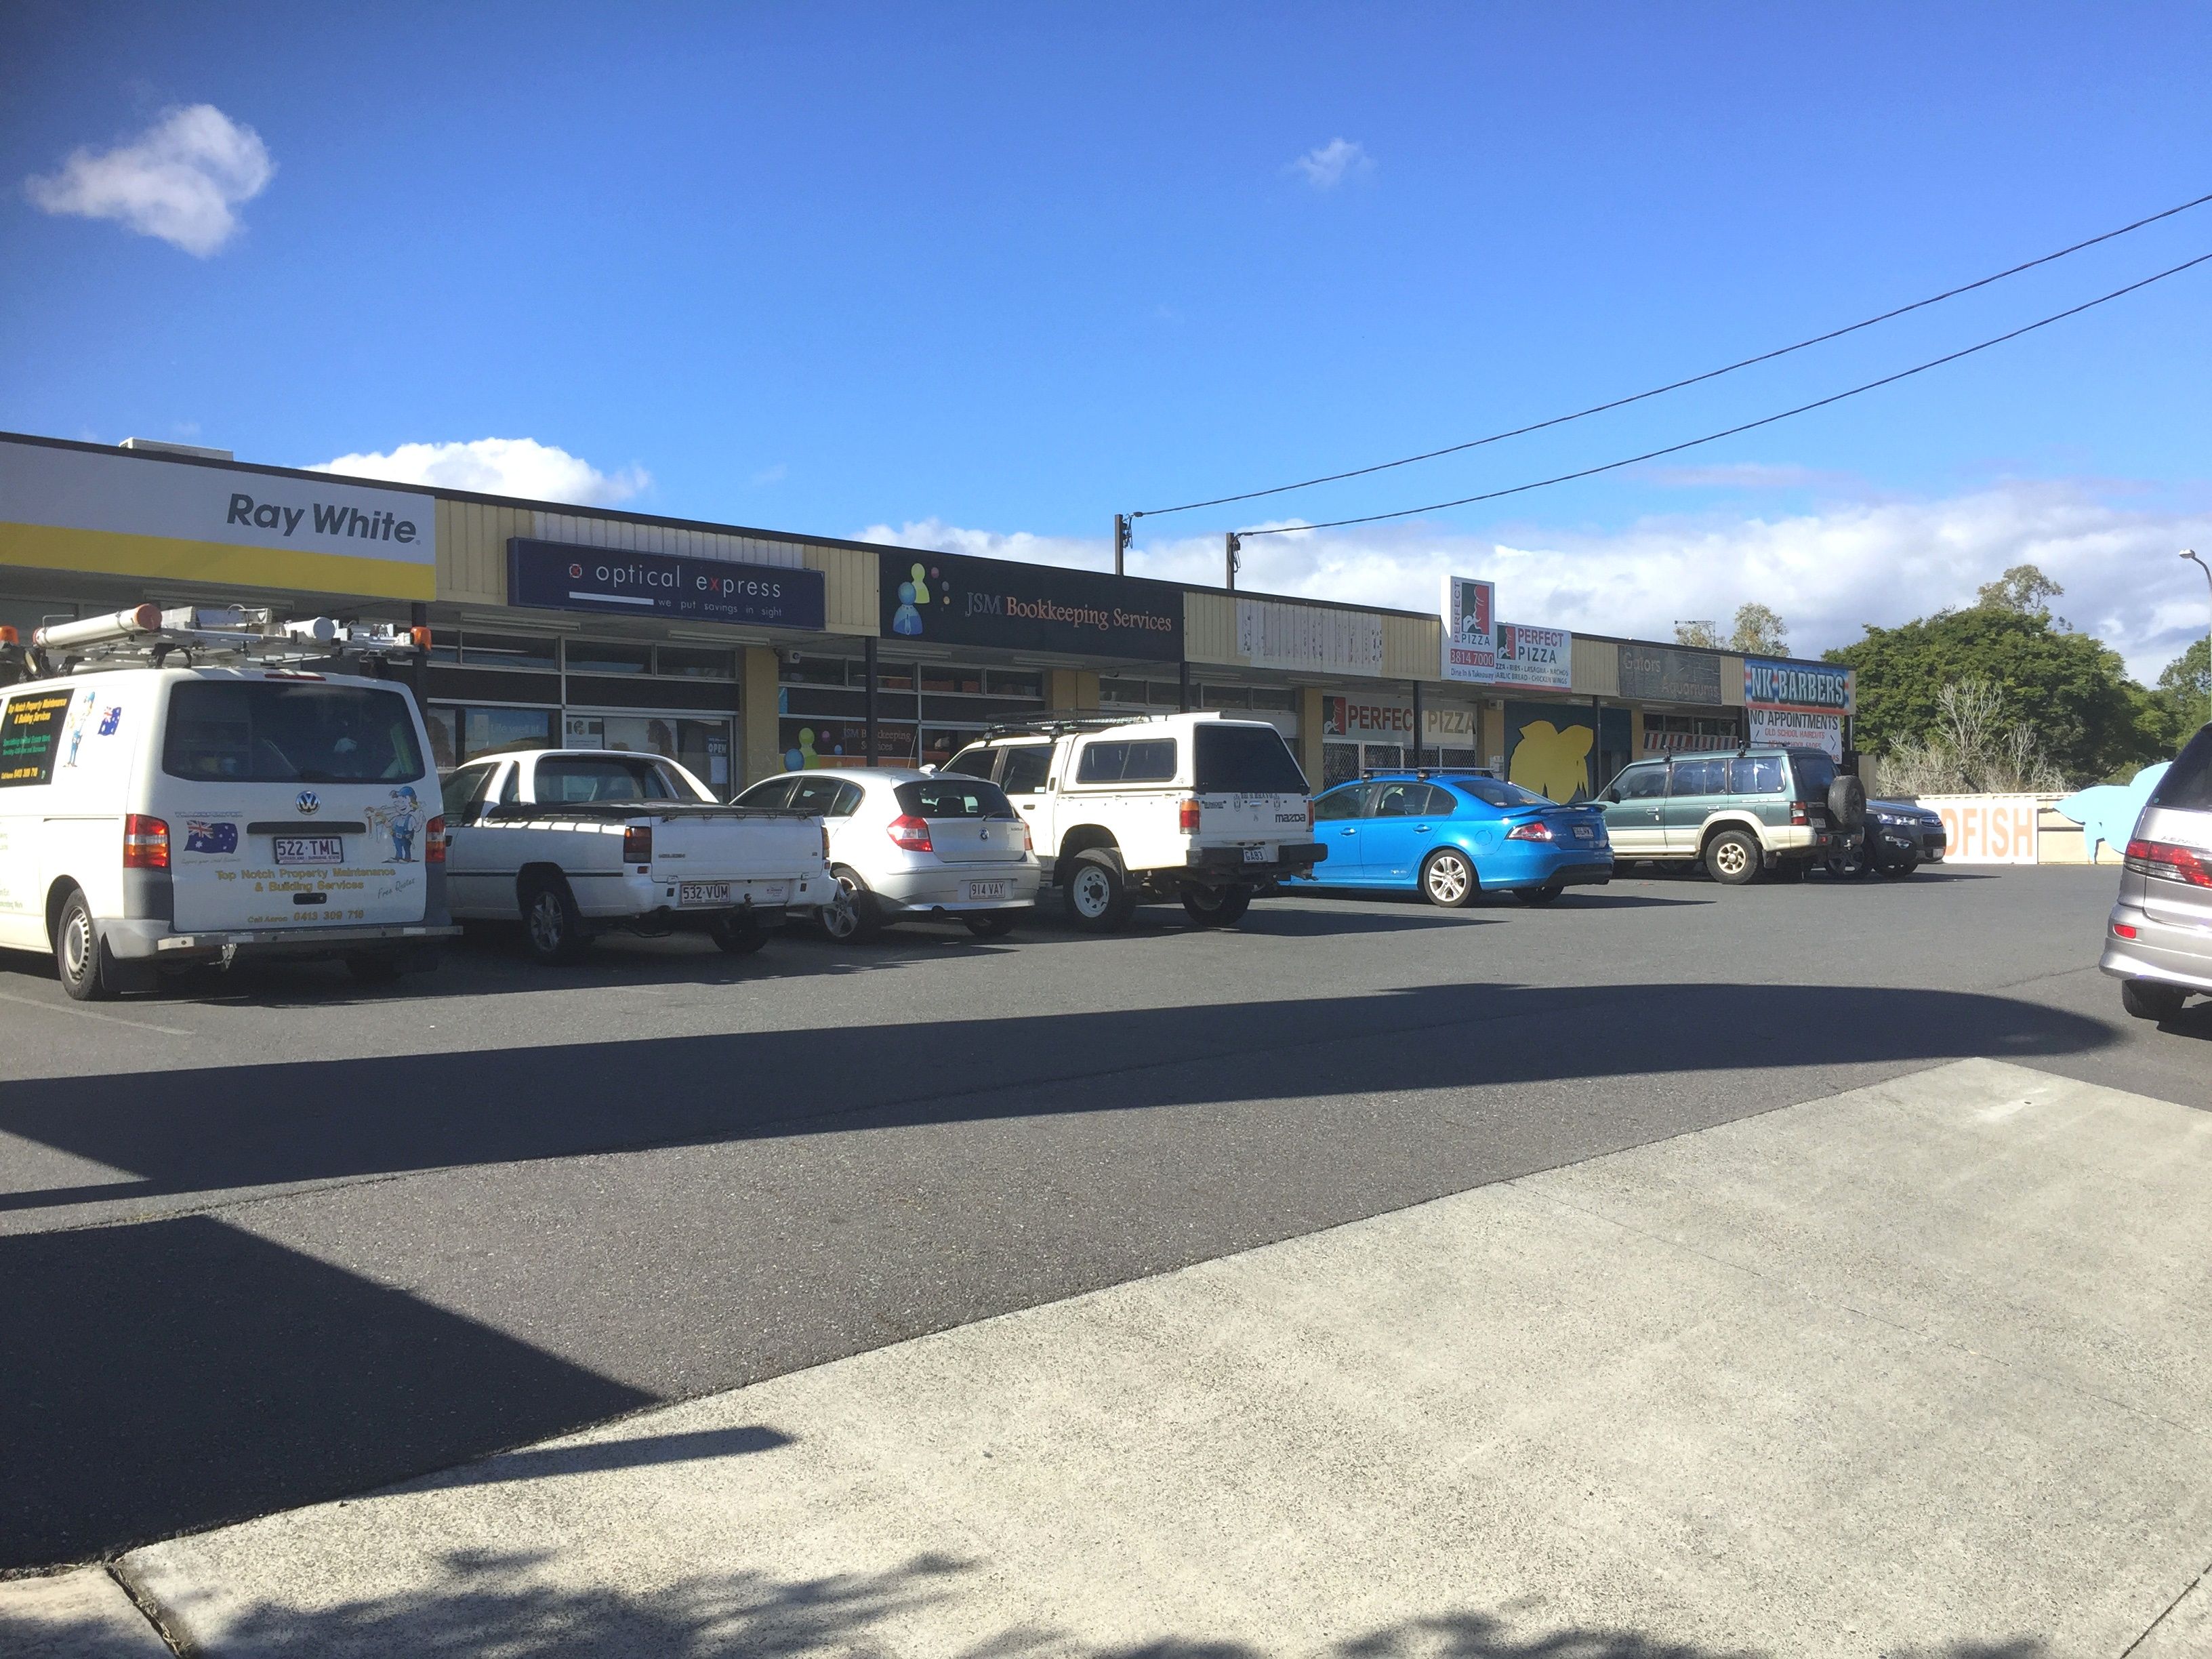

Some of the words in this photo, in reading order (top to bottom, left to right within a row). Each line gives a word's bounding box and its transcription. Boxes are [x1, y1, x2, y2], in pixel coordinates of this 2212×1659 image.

[226, 493, 305, 537] Ray
[312, 503, 417, 544] White
[596, 564, 680, 588] optical
[696, 576, 781, 598] express
[658, 599, 672, 607] we
[680, 600, 696, 610] put
[704, 602, 738, 615] savings
[745, 606, 754, 614] in
[761, 607, 782, 619] sight
[964, 591, 1002, 617] JSM
[1006, 596, 1109, 631] Bookkeeping
[1113, 607, 1172, 632] Services
[1461, 633, 1491, 647] PIZZA
[1517, 628, 1564, 648] PERFECT
[1450, 650, 1473, 664] 3814
[1473, 653, 1494, 666] 7000
[1518, 646, 1557, 664] PIZZA
[1495, 662, 1506, 670] ZZA
[1495, 672, 1511, 680] ARLIC
[1750, 667, 1774, 700] NK
[1777, 669, 1846, 705] BARBERS
[1347, 705, 1414, 732] PERFEC
[1427, 711, 1477, 735] PIZZA
[1749, 710, 1764, 726] NO
[1767, 711, 1839, 731] APPOINTMENTS
[1777, 729, 1799, 738] SCHOOL
[1799, 730, 1826, 739] HAIRCUTS
[708, 743, 727, 754] OPEN
[1275, 813, 1307, 823] mazda
[215, 870, 236, 882] Top
[241, 869, 276, 879] Notch
[279, 868, 328, 880] Property
[332, 867, 396, 877] Maintenance
[254, 882, 264, 893] &
[268, 882, 313, 893] Building
[316, 880, 365, 890] Services
[377, 887, 393, 899] Free
[293, 911, 318, 921] 0413
